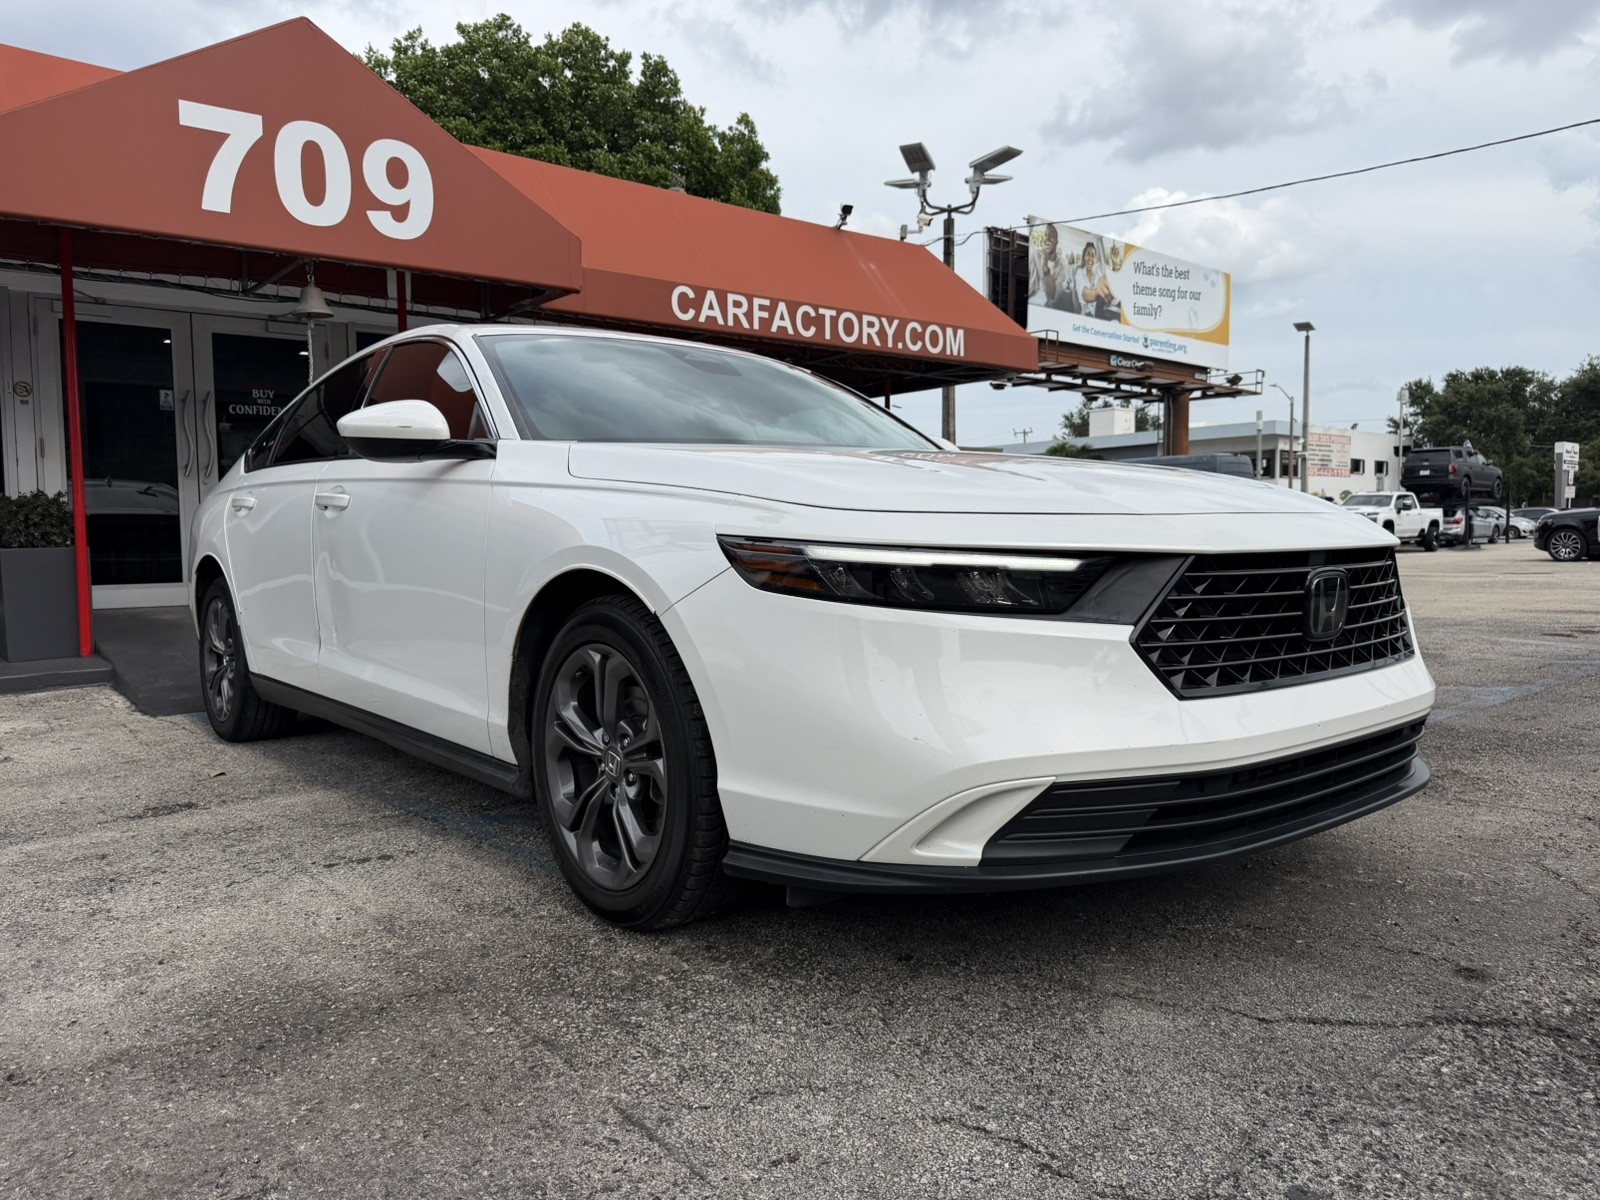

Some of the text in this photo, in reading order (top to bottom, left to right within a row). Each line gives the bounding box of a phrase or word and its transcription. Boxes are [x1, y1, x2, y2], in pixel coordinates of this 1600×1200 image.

[178, 99, 434, 240] 709
[1133, 261, 1190, 280] What's the best
[1133, 282, 1202, 302] theme song for our
[1133, 302, 1162, 320] family?
[671, 285, 965, 357] CARFACTORY.COM
[1072, 323, 1140, 344] Get the Conversation Started
[1150, 338, 1187, 354] parenting.org
[252, 389, 275, 399] BUY
[228, 404, 285, 416] CONFIDEN
